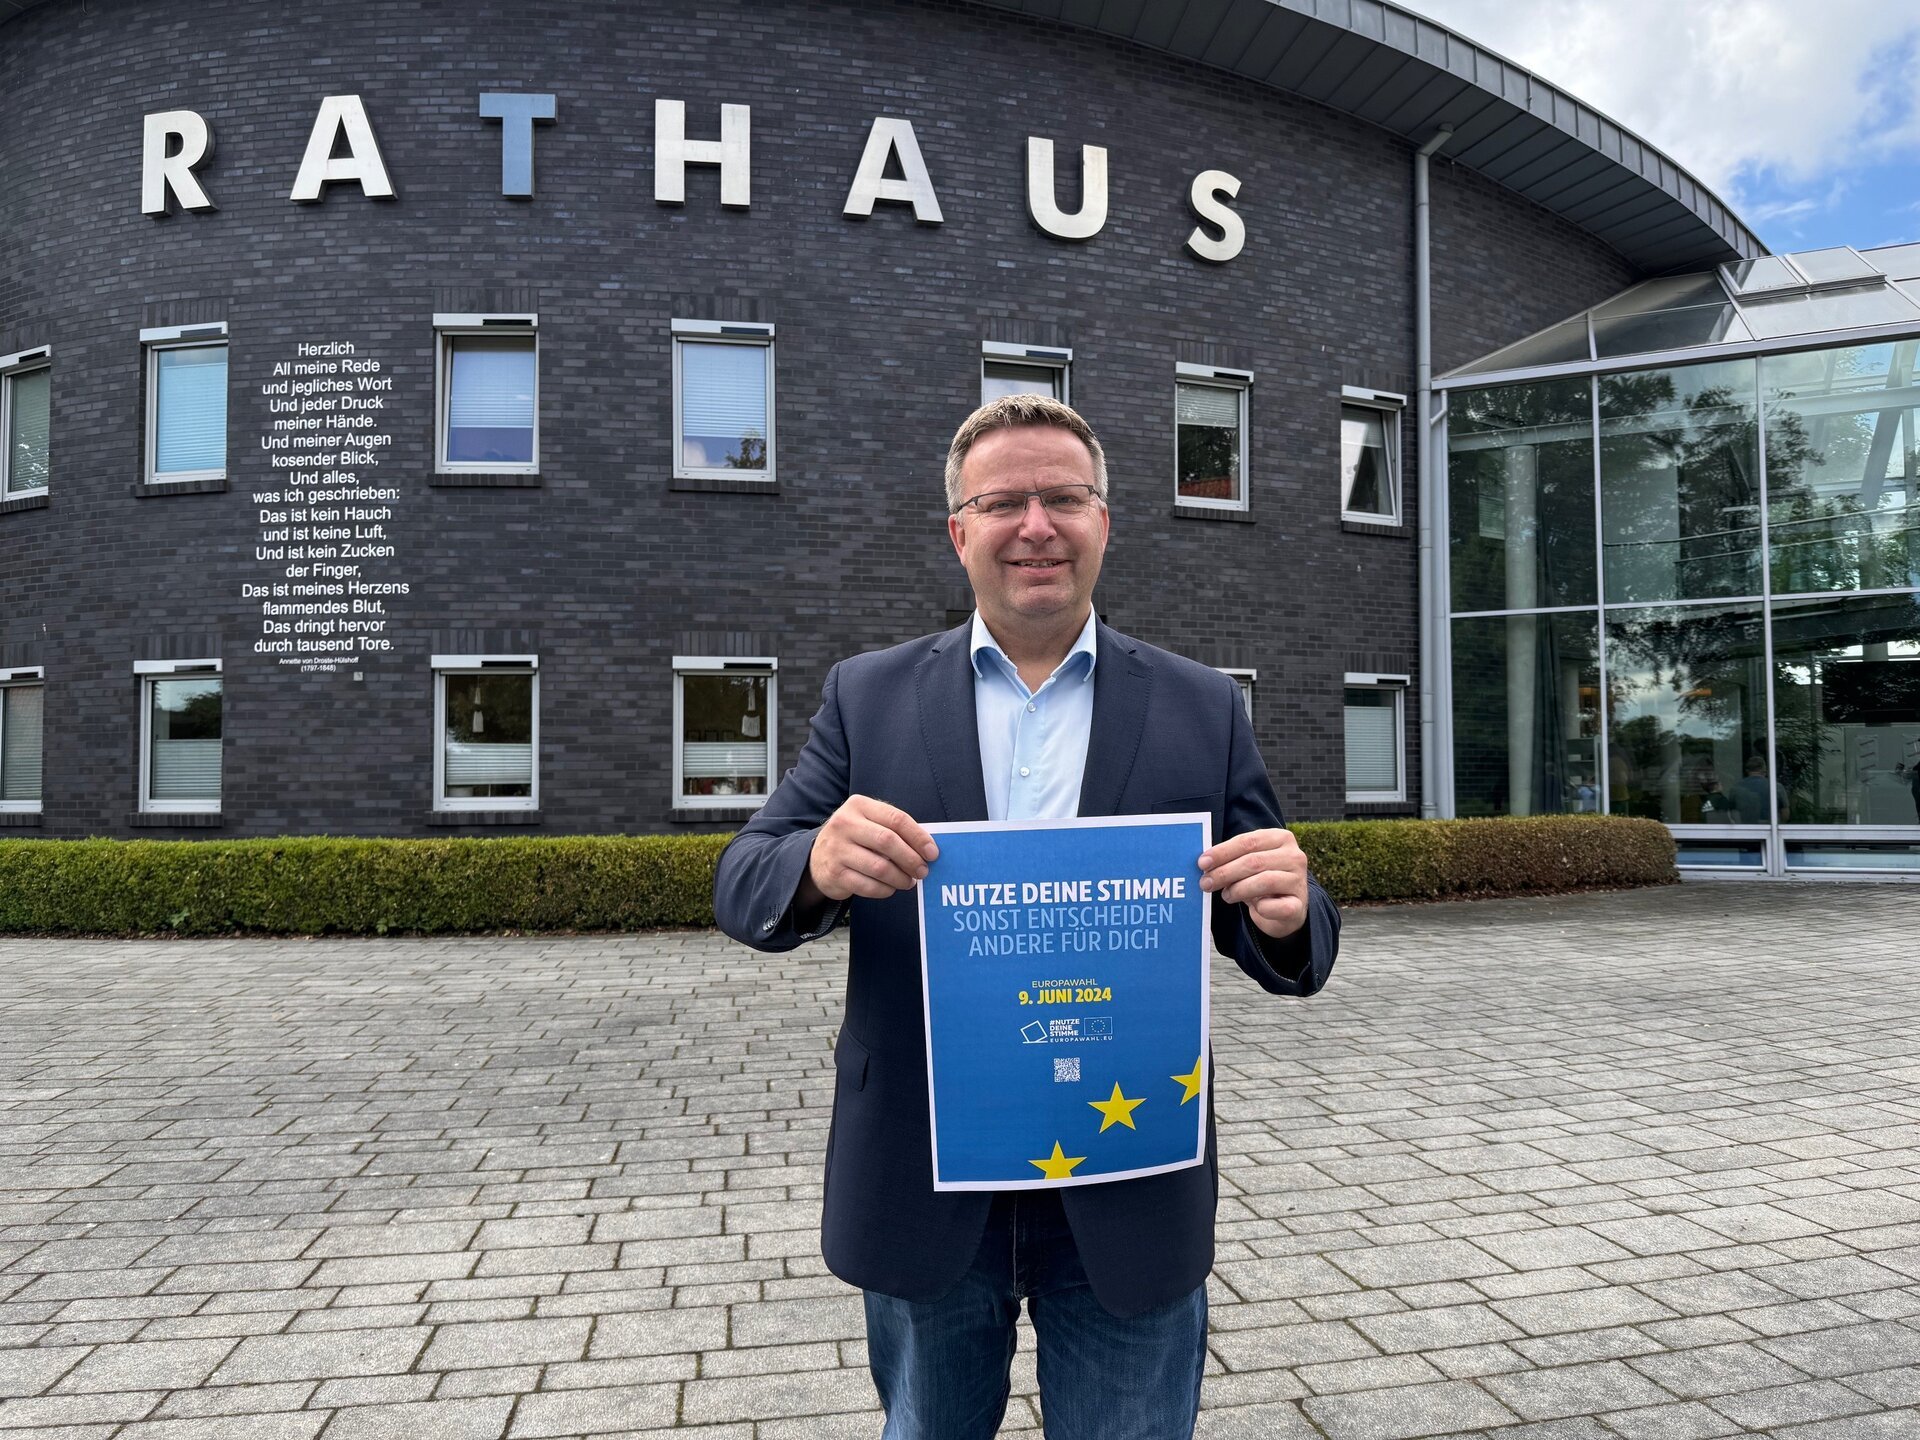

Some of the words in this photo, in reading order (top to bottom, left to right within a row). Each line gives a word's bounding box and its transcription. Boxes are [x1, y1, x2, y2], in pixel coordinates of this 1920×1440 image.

[141, 92, 1247, 264] RATHAUS
[298, 341, 355, 357] Herzlich
[273, 361, 291, 376] All
[294, 360, 338, 374] meine
[342, 358, 381, 373] Rede
[262, 380, 288, 395] und
[291, 379, 353, 396] jegliches
[357, 377, 392, 391] Wort
[270, 398, 298, 412] Und
[301, 398, 338, 414] jeder
[341, 395, 384, 410] Druck
[274, 417, 322, 431] meiner
[326, 414, 377, 429] Hände.
[261, 435, 289, 449] Und
[293, 434, 342, 448] meiner
[344, 432, 392, 448] Augen
[272, 452, 337, 467] kosender
[340, 451, 379, 466] Blick,
[290, 471, 318, 485] Und
[322, 470, 360, 485] alles,
[252, 492, 281, 503] was
[284, 489, 304, 502] ich
[308, 486, 400, 504] geschrieben:
[259, 510, 287, 523] Das
[291, 508, 307, 522] ist
[311, 507, 340, 521] kein
[344, 506, 391, 520] Hauch
[263, 527, 289, 542] und
[293, 527, 309, 540] ist
[313, 526, 351, 540] keine
[355, 524, 387, 539] Luft,
[256, 546, 284, 560] Und
[288, 545, 304, 559] ist
[308, 545, 337, 558] kein
[341, 544, 395, 558] Zucken
[286, 564, 309, 578] der
[313, 563, 362, 579] Finger,
[242, 583, 269, 597] Das
[273, 582, 289, 596] ist
[292, 582, 344, 596] meines
[348, 581, 410, 595] Herzens
[262, 600, 349, 615] flammendes
[352, 599, 386, 614] Blut,
[263, 620, 291, 634] Das
[295, 619, 335, 636] dringt
[339, 618, 386, 632] hervor
[254, 639, 293, 652] durch
[297, 638, 353, 651] tausend
[358, 637, 395, 651] Tore.
[941, 883, 1017, 907] NUTZE
[1022, 881, 1092, 904] DEINE
[1097, 877, 1186, 901] STIMME
[953, 908, 1021, 932] SONST
[1028, 903, 1173, 929] ENTSCHEIDEN
[968, 933, 1054, 957] ANDERE
[1061, 927, 1101, 953] FÜR
[1108, 928, 1159, 950] DICH
[1032, 979, 1098, 988] EUROPAWAHL
[1018, 991, 1033, 1005] 9.
[1037, 989, 1072, 1005] JUNI
[1075, 987, 1112, 1003] 2024
